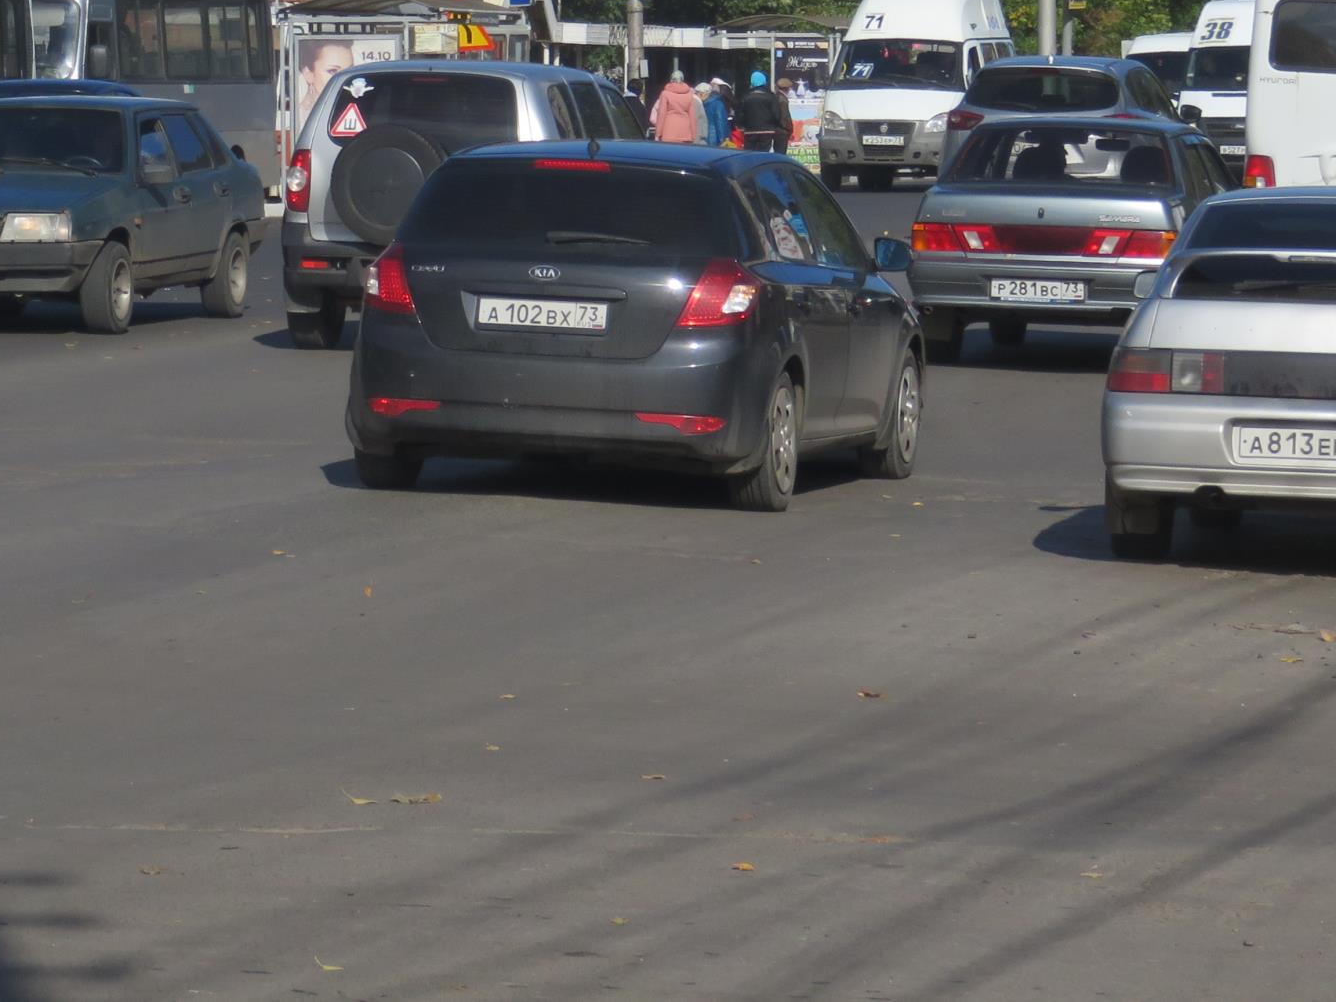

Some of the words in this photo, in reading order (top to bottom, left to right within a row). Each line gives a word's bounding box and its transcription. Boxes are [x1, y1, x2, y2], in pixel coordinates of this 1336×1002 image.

[865, 15, 884, 28] 71
[1200, 21, 1233, 40] 38
[361, 51, 391, 61] 14.10
[852, 65, 872, 76] 71
[535, 268, 555, 277] KIA
[998, 281, 1059, 296] Р281ВС
[1064, 282, 1078, 293] 73
[488, 303, 572, 326] А102ВХ
[579, 305, 598, 322] 73
[1249, 431, 1336, 456] А813Е
